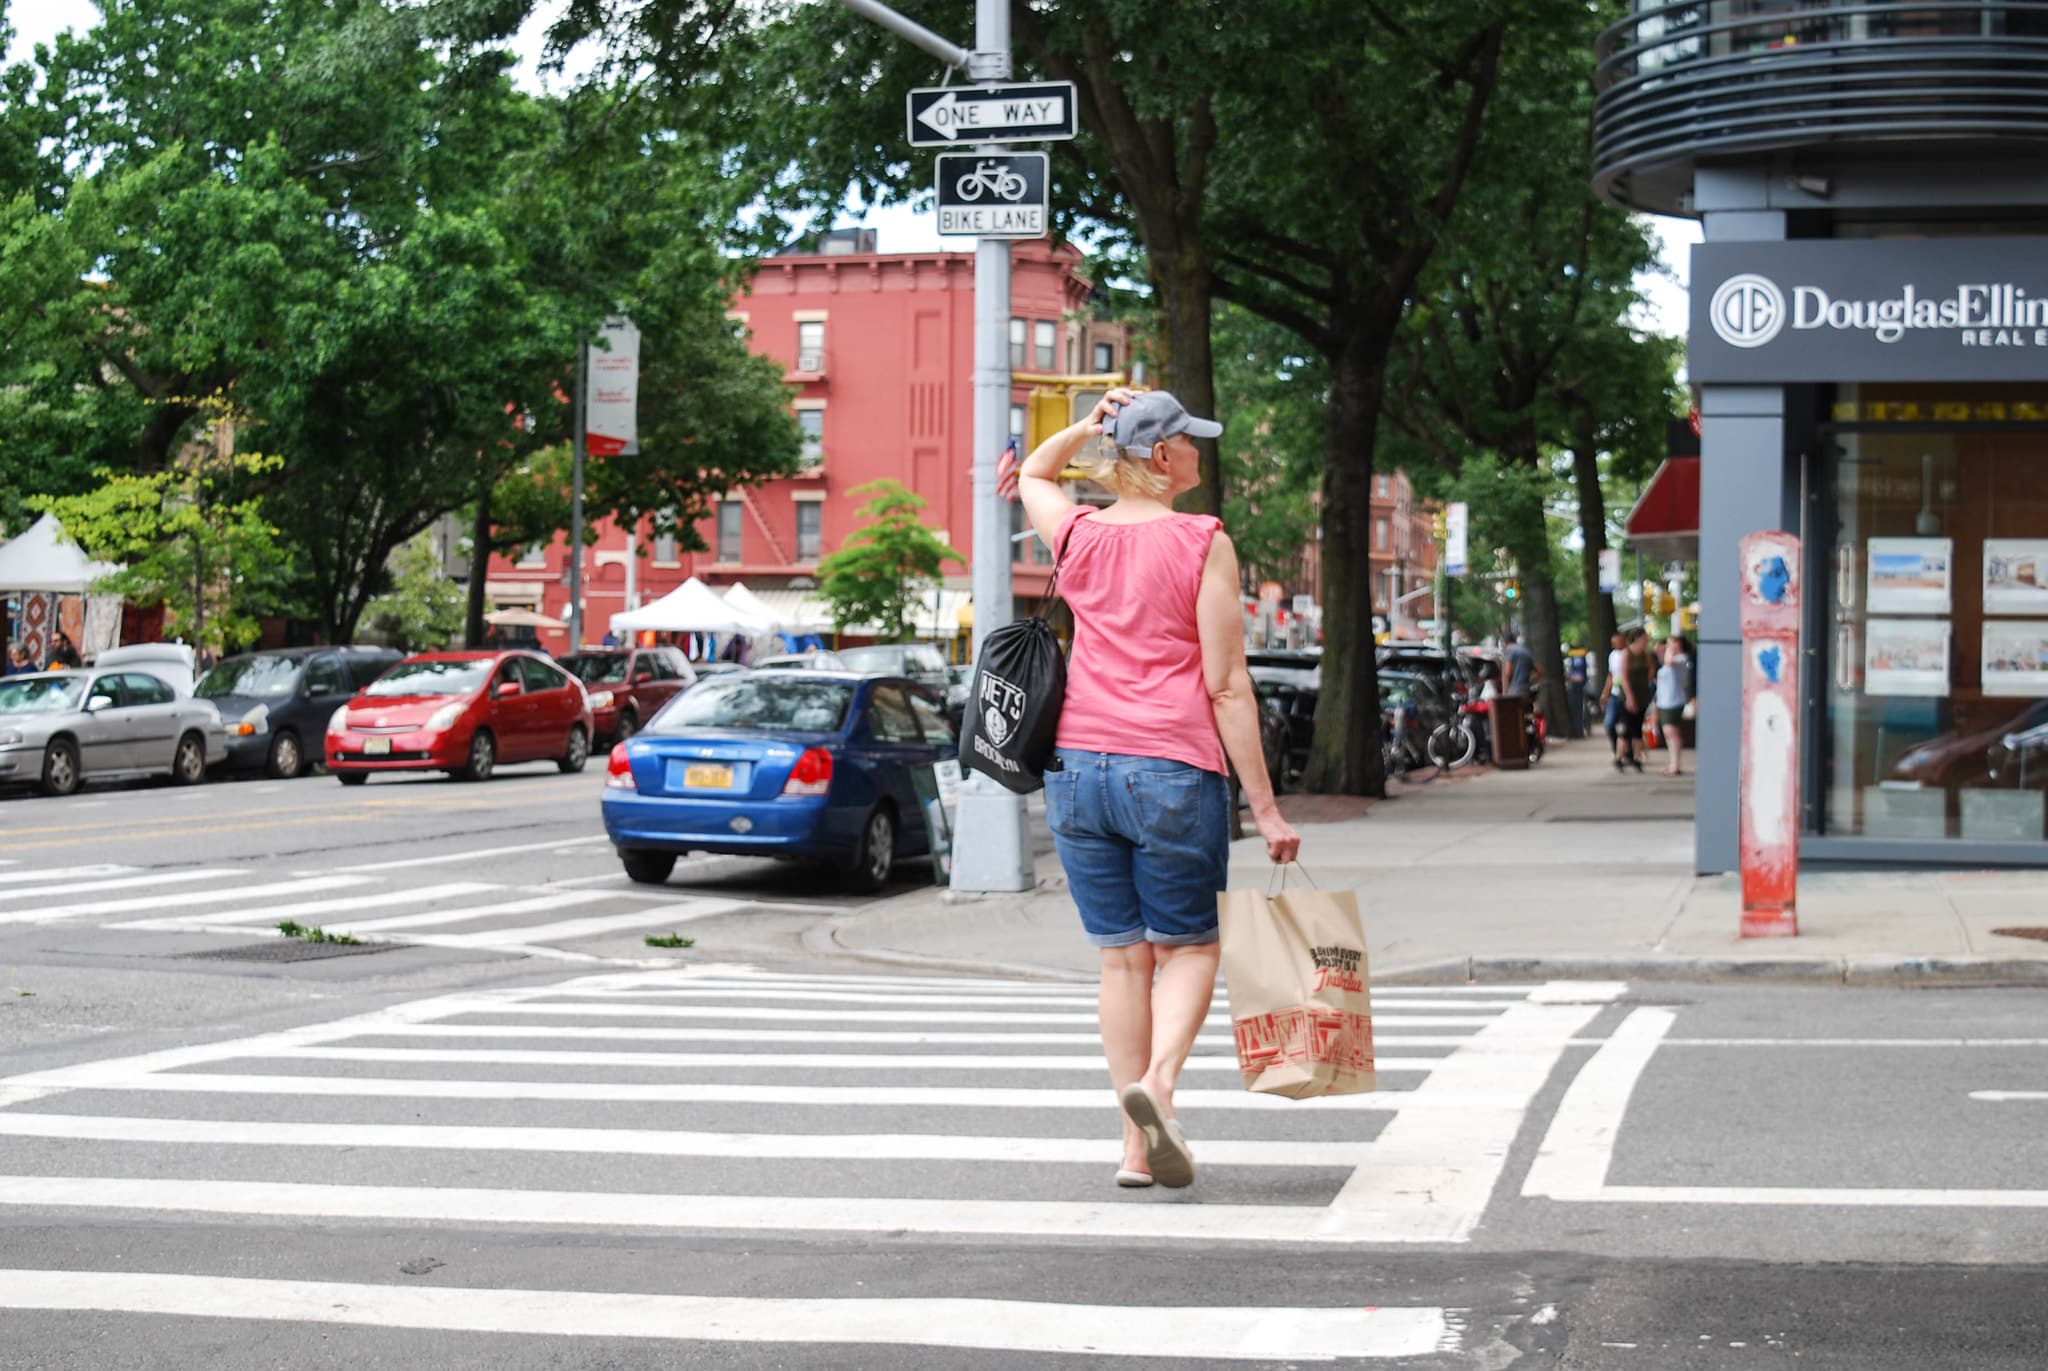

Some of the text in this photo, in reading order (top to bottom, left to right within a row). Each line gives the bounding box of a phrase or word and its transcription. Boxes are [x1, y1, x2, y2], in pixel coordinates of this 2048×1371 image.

[935, 102, 1053, 127] ONE WAY
[942, 210, 1039, 230] BIKE LANE
[1962, 329, 2026, 347] REAL
[980, 674, 1023, 721] NETS
[974, 734, 1020, 773] BROOKLYN
